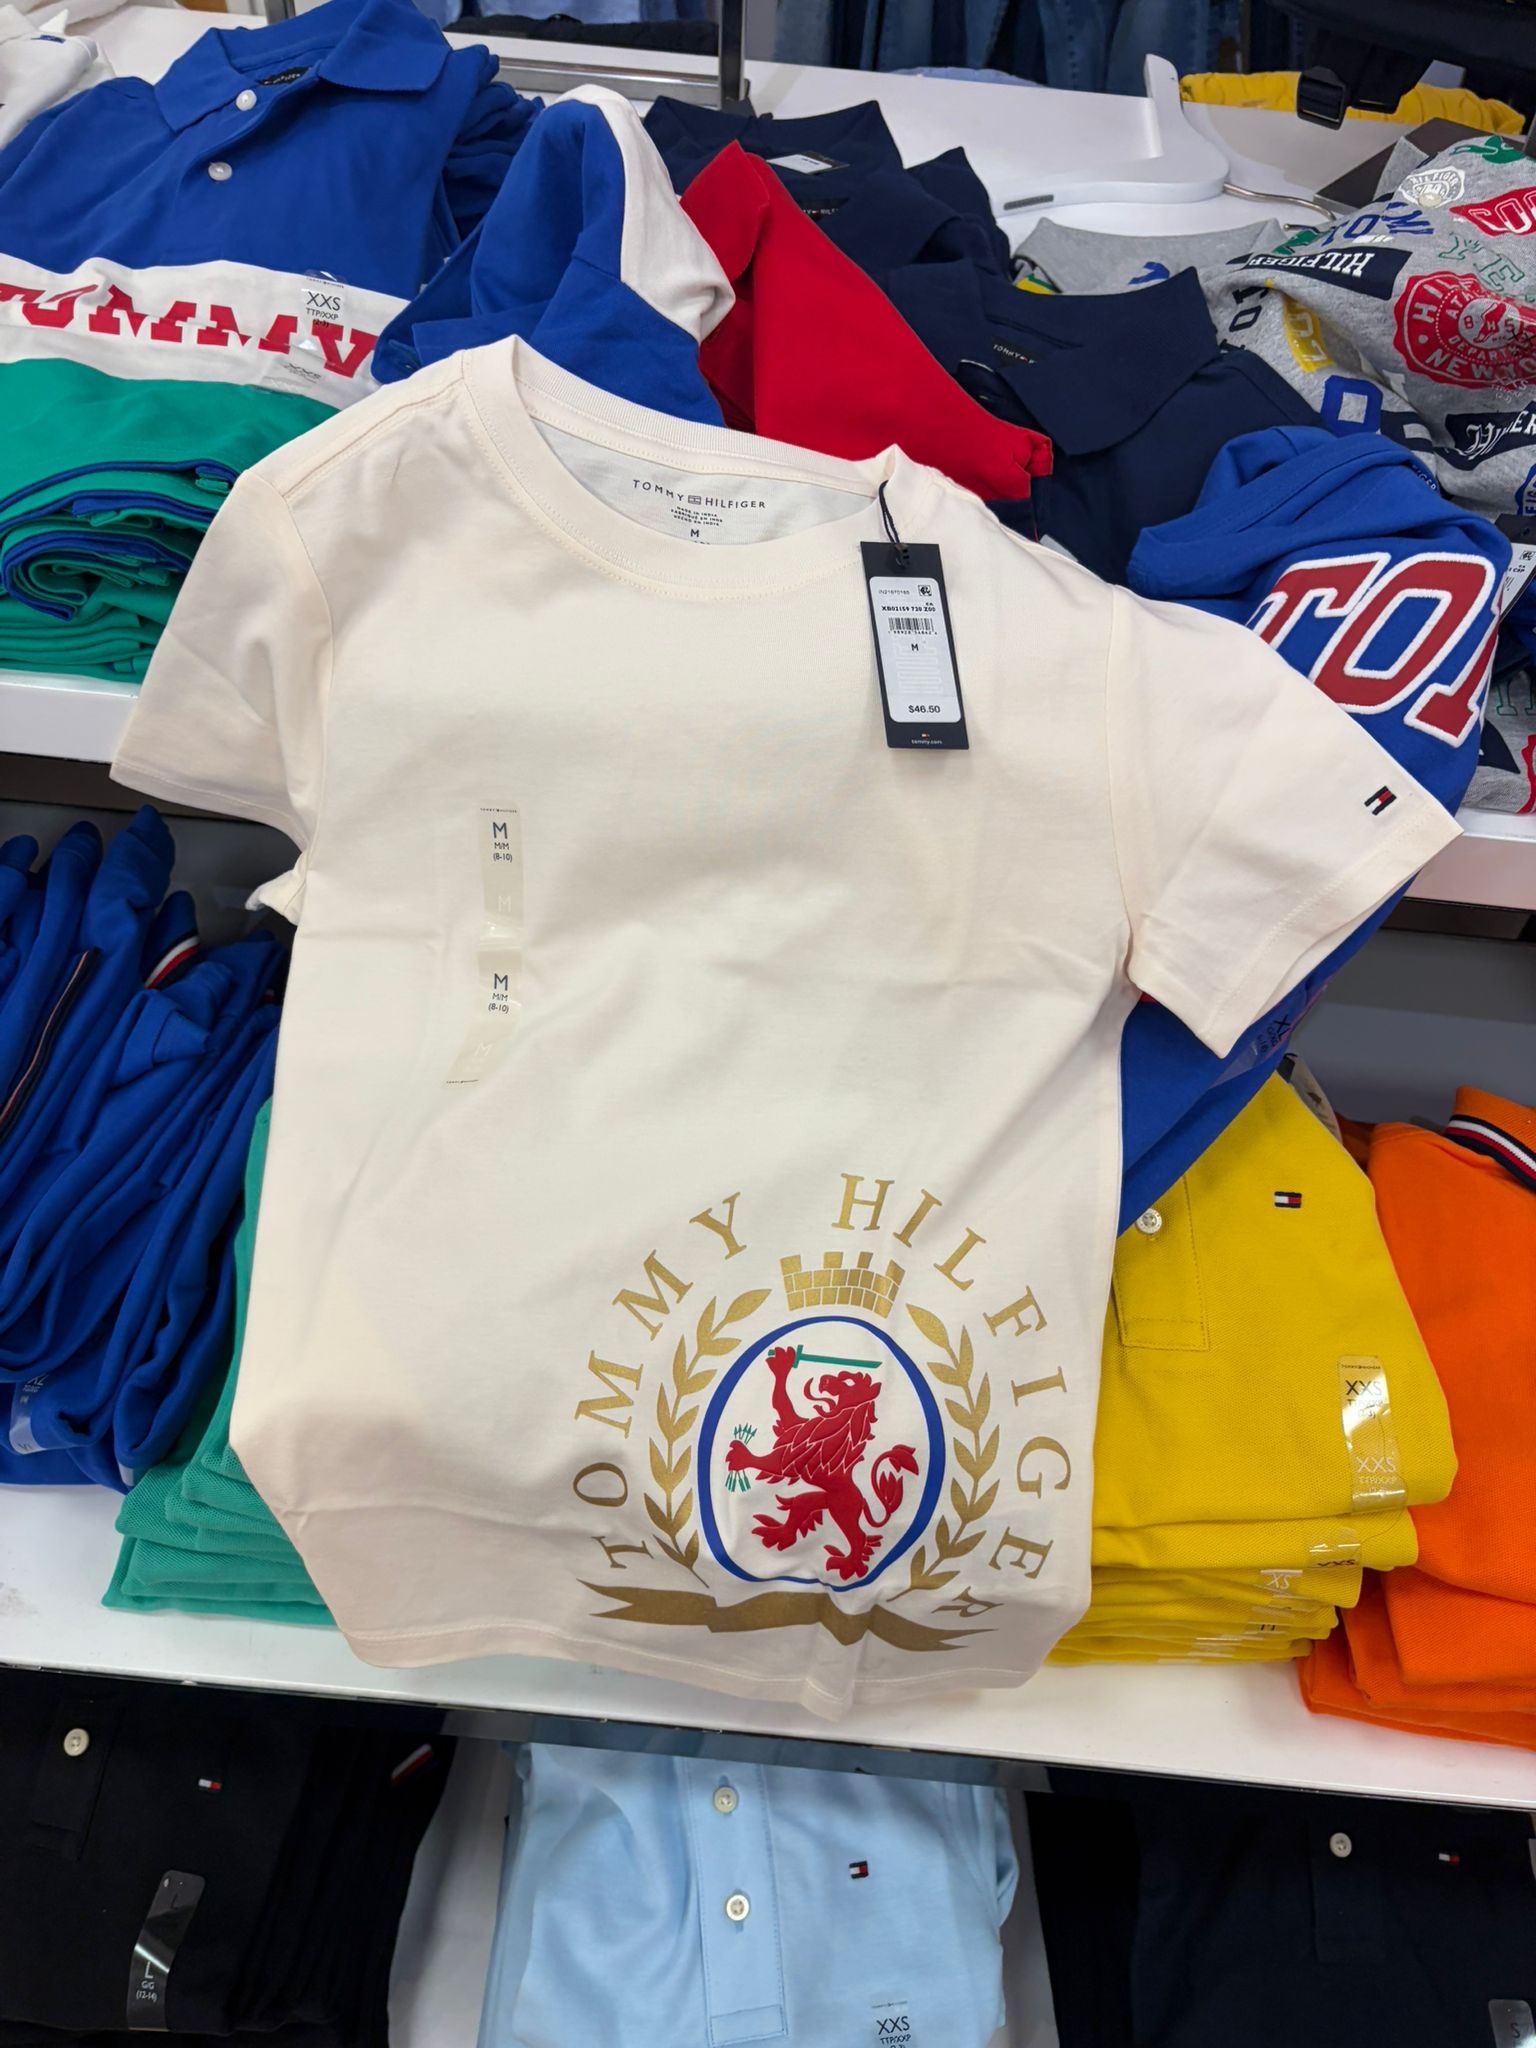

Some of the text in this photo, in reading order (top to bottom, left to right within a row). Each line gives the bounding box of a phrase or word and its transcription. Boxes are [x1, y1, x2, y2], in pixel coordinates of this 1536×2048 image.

[1468, 190, 1536, 233] CO
[306, 290, 342, 311] XXS
[1425, 348, 1495, 380] NEW
[632, 479, 766, 509] TOMMY HILFIGER
[690, 529, 699, 538] M
[911, 643, 919, 652] M
[908, 704, 941, 714] $46.50
[492, 821, 508, 839] M
[493, 852, 513, 863] (8-10)
[493, 972, 508, 991] M
[487, 1002, 510, 1015] (8-10)
[573, 1172, 1072, 1620] TOMMY HILFIGER
[1345, 1379, 1382, 1396] XXS
[1356, 1456, 1397, 1473] XXS
[144, 1961, 154, 1979] L
[876, 2015, 910, 2036] XXS
